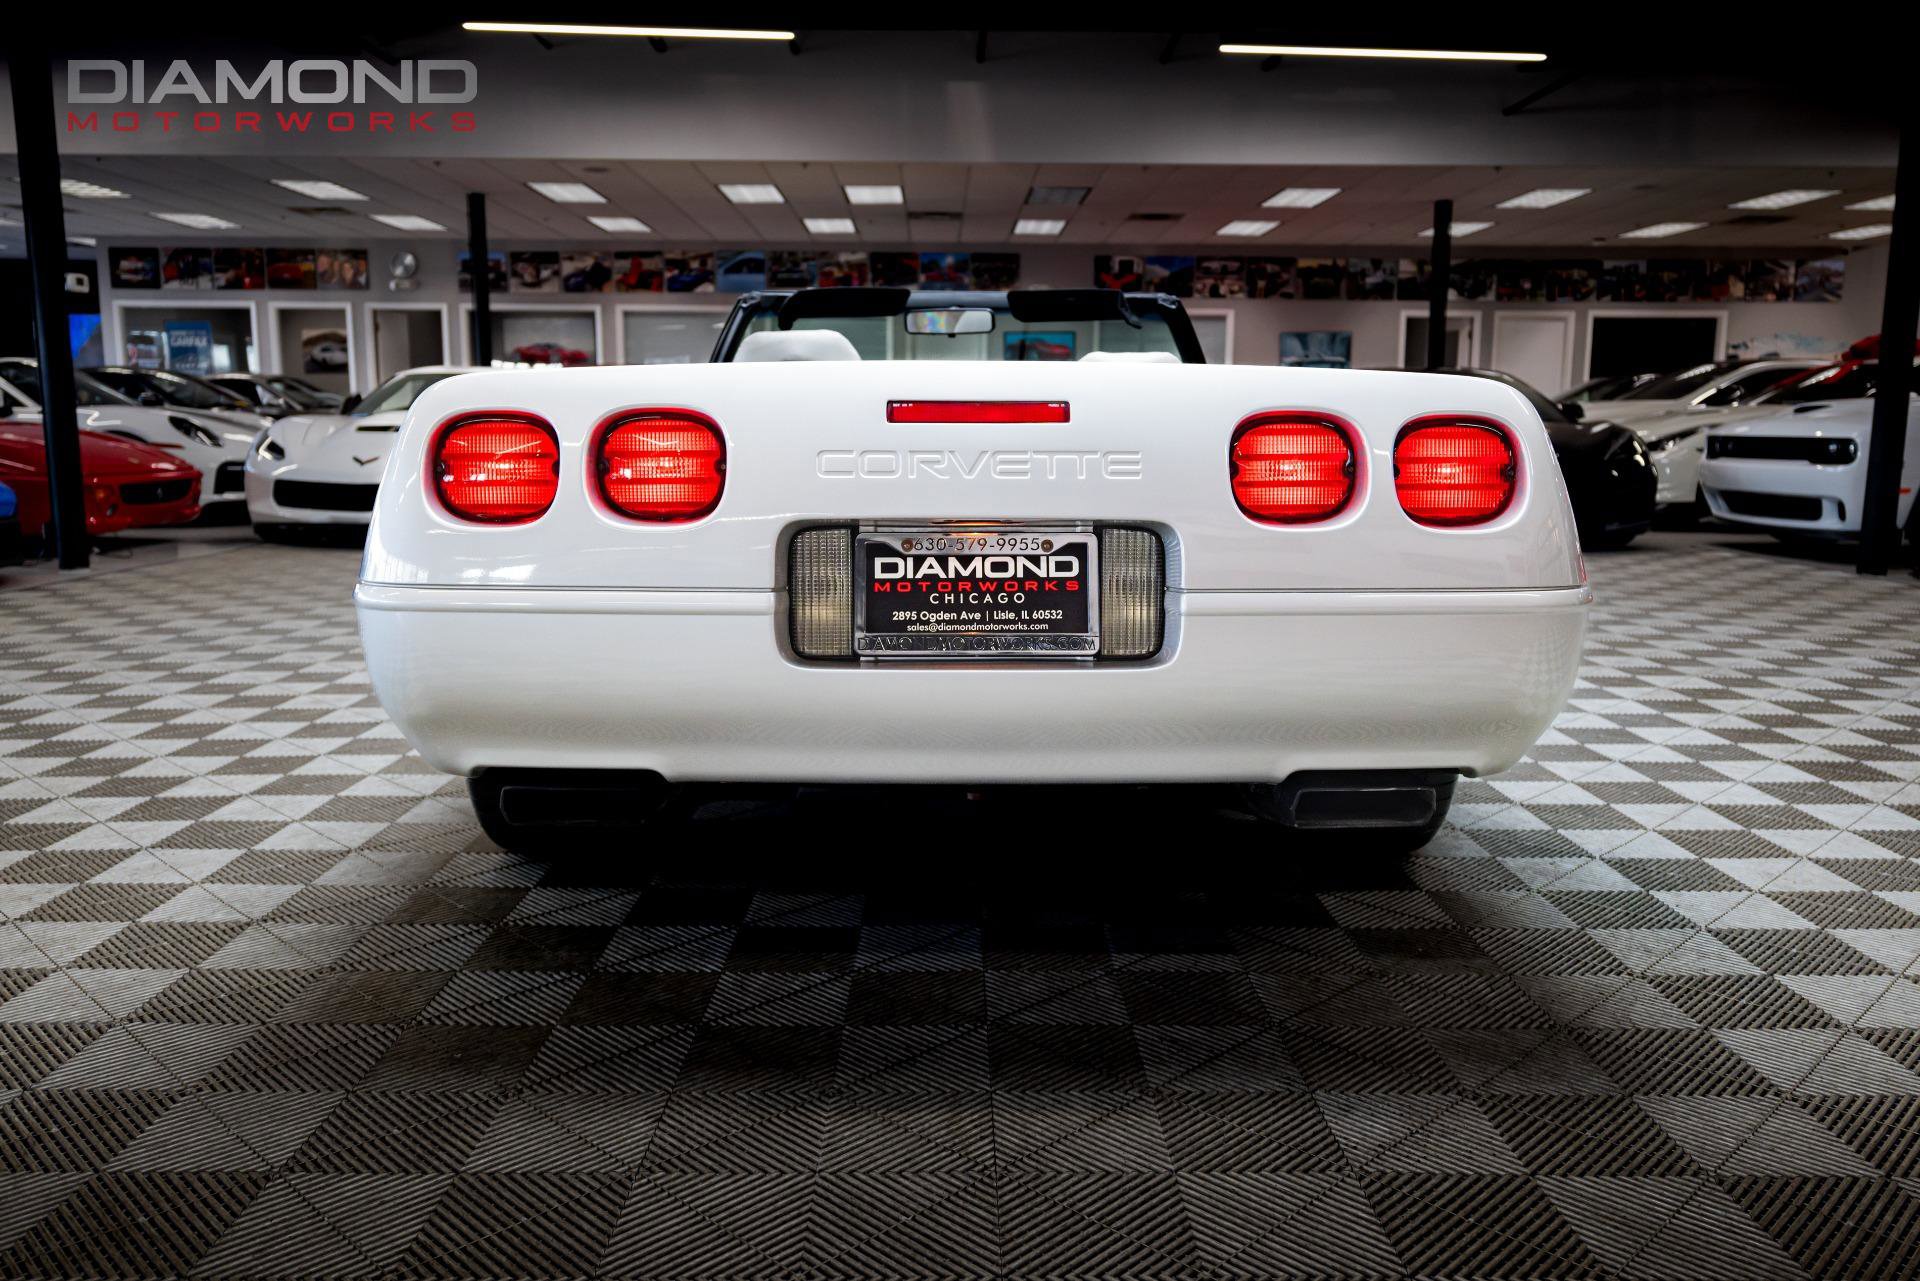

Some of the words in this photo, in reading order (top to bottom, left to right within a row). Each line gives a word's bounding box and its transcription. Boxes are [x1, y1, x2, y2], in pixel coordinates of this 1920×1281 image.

[815, 449, 1143, 480] CORVETTE
[914, 537, 1041, 551] 630-579-9955
[874, 555, 1080, 579] DIAMOND
[873, 580, 1080, 592] MOTORWORKS
[930, 592, 1026, 604] CHICAGO
[892, 611, 917, 621] 2895
[920, 611, 957, 623] Ogden
[960, 611, 981, 620] Ave
[993, 610, 1019, 621] Lisle,
[1021, 610, 1030, 620] IL
[1032, 610, 1063, 620] 60532
[907, 622, 1049, 632] sales@diamondmotorworks.com
